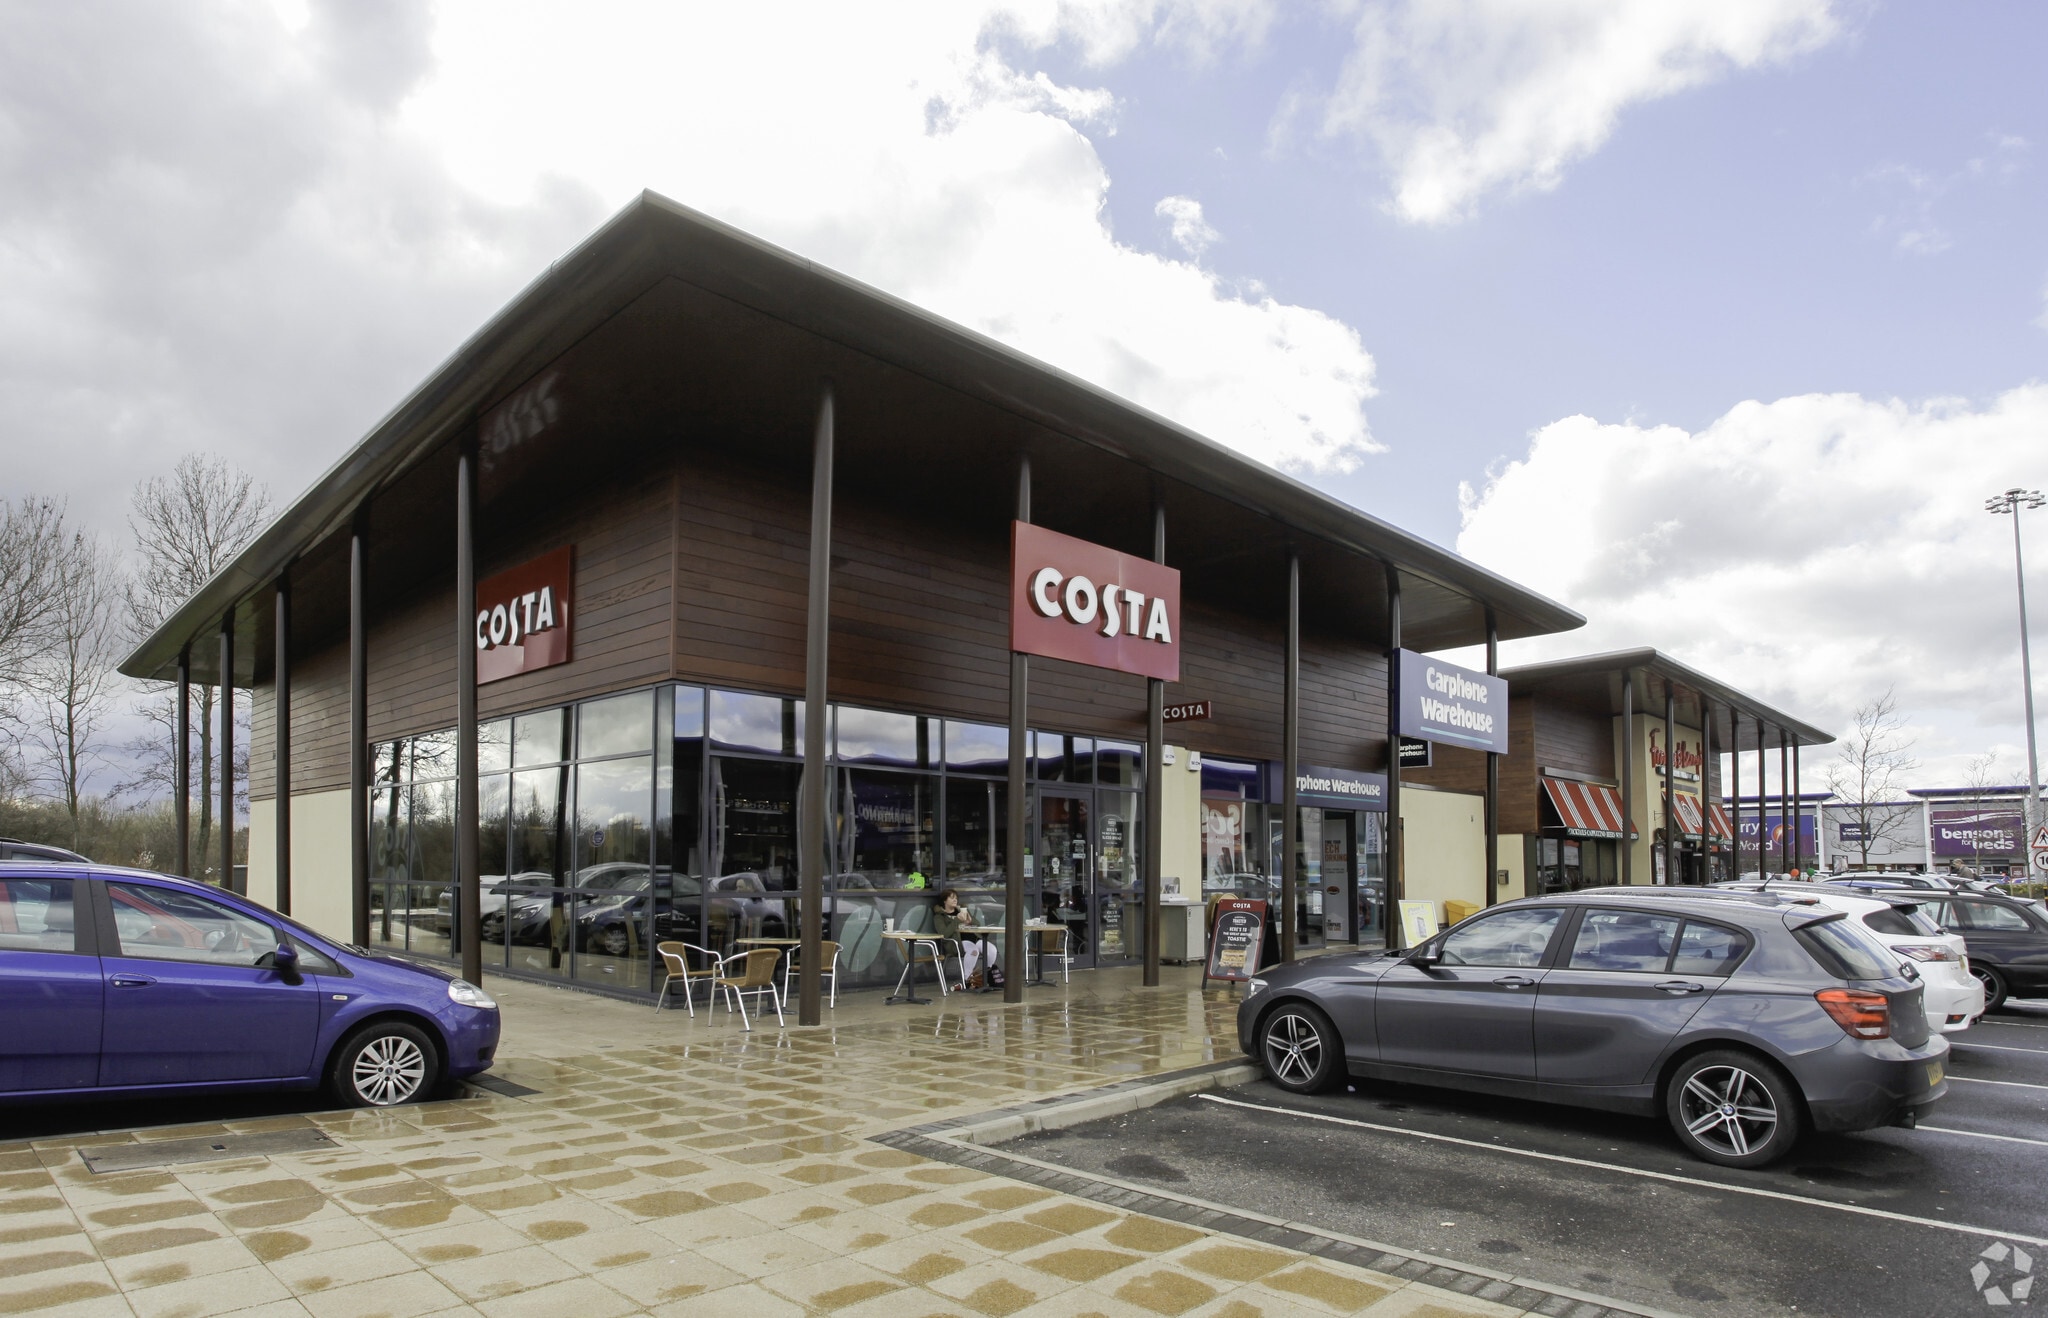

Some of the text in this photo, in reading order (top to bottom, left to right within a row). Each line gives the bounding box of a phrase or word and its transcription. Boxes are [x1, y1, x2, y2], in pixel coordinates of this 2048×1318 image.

[1031, 567, 1172, 643] COSTA
[477, 586, 554, 649] COSTA
[1426, 667, 1488, 704] Carphone
[1163, 704, 1204, 719] COSTA
[1420, 696, 1493, 733] Warehouse
[1399, 744, 1424, 752] arphone
[1296, 775, 1381, 796] rphone Warehouse
[1941, 828, 2014, 839] bensons
[1739, 840, 1773, 850] Word
[1972, 839, 2015, 849] beds
